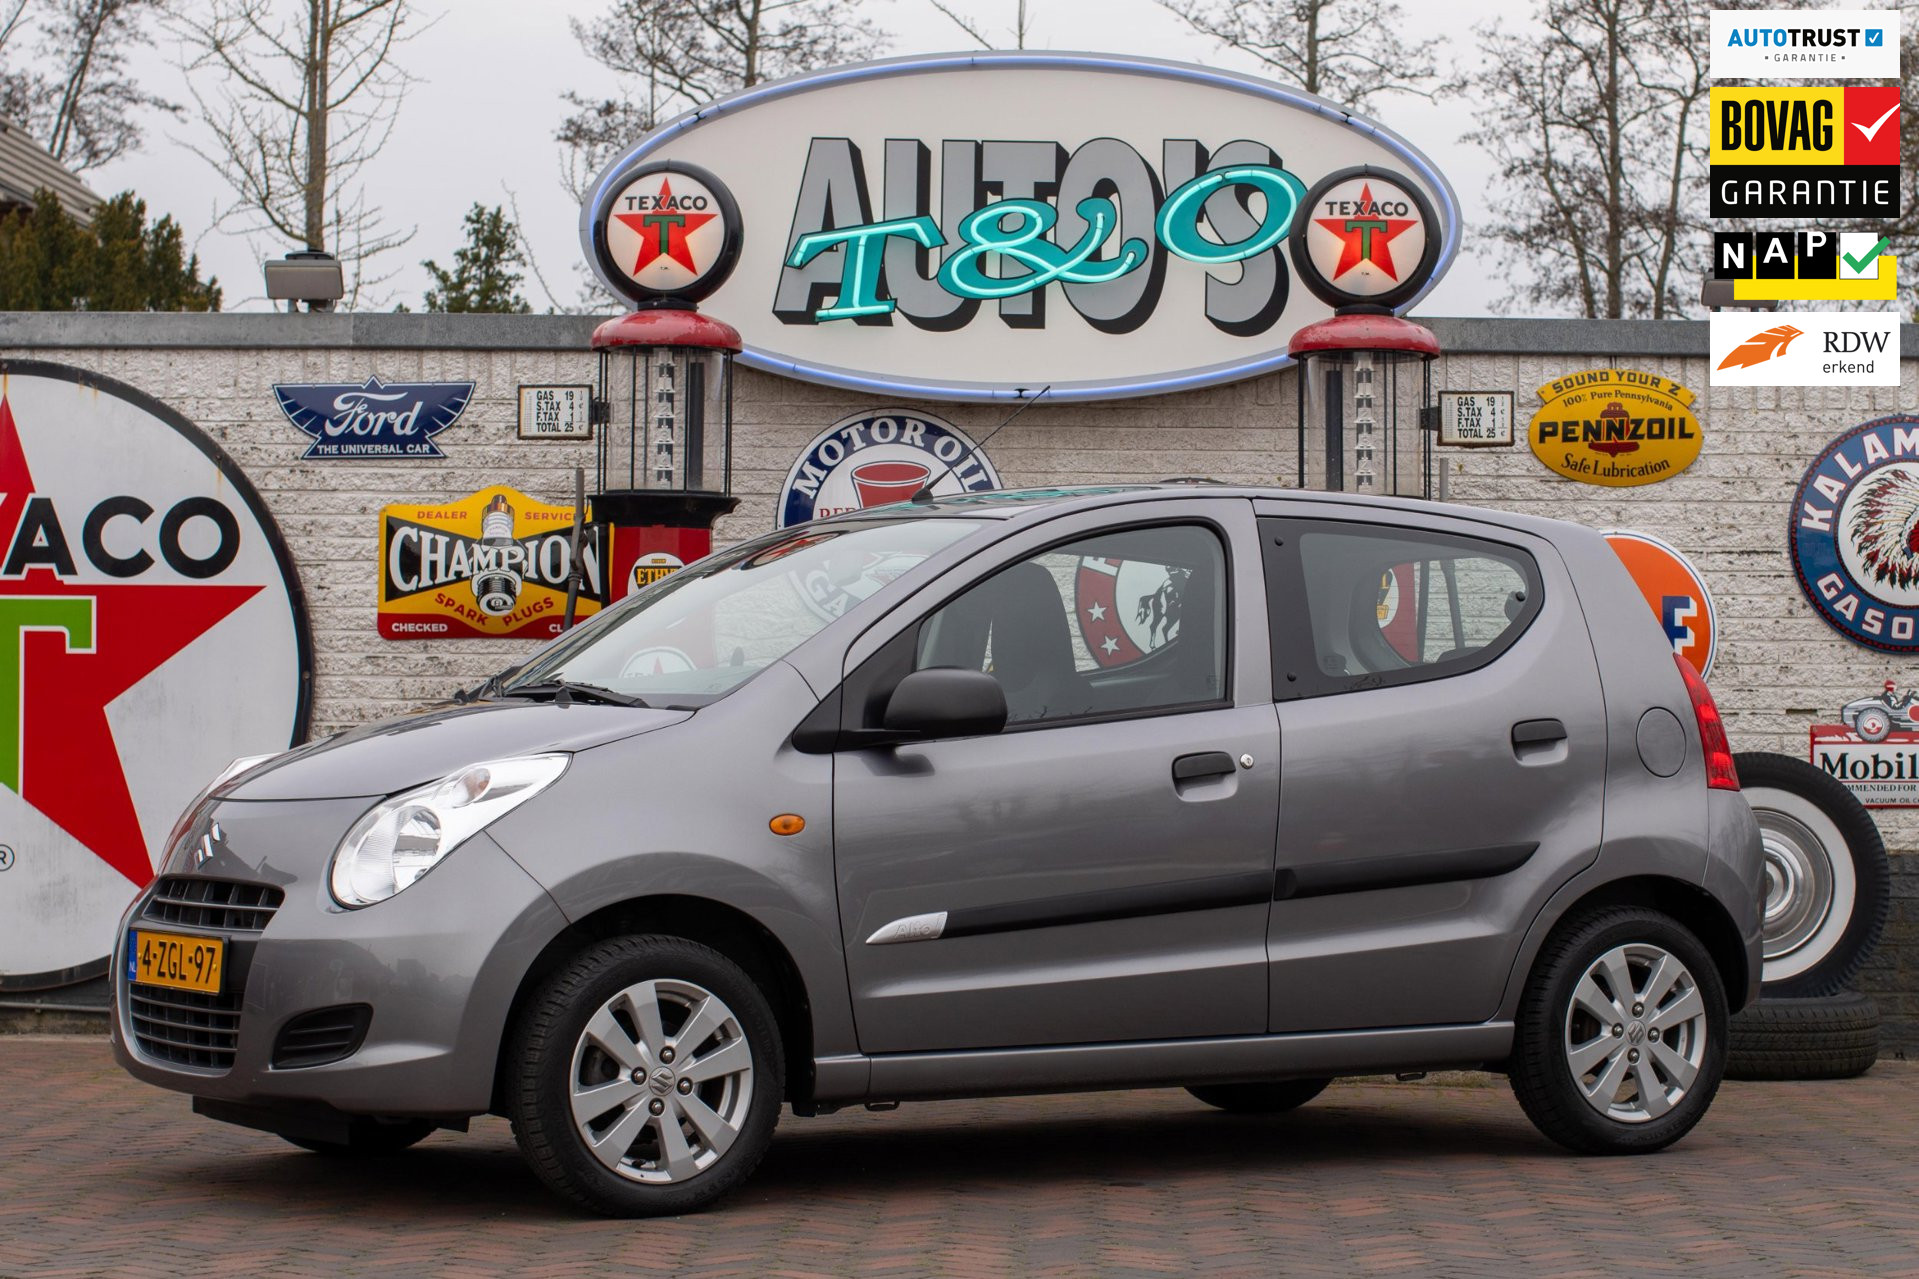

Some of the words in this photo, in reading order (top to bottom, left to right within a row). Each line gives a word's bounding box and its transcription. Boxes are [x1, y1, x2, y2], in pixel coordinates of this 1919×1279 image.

[625, 195, 708, 211] TEXACO
[1325, 201, 1409, 217] TEXACO
[1552, 371, 1610, 394] SOUND
[1615, 371, 1661, 388] YOUR
[536, 390, 554, 401] GAS
[564, 390, 574, 401] 19
[1590, 391, 1613, 401] Pure
[1614, 389, 1674, 412] Pennsylvania
[536, 401, 561, 411] S.TAX
[569, 401, 574, 411] 4
[1457, 396, 1475, 407] GAS
[1486, 396, 1495, 407] 19
[324, 391, 424, 437] Ford
[536, 412, 560, 422] F.TAX
[1457, 407, 1482, 417] S.TAX
[1490, 407, 1496, 417] 4
[536, 422, 561, 432] TOTAL
[564, 422, 574, 432] 25
[1457, 418, 1481, 428] F.TAX
[1457, 428, 1483, 438] TOTAL
[1486, 428, 1496, 438] 25
[1538, 417, 1695, 444] PENNZOIL
[317, 444, 339, 454] THE
[341, 444, 403, 454] UNIVERSAL
[407, 444, 430, 454] CAR
[792, 417, 928, 500] MOTOR
[933, 435, 988, 492] OIL
[1561, 453, 1591, 474] Safe
[1593, 458, 1670, 478] Lubrication
[417, 511, 468, 520] DEALER
[524, 511, 579, 521] SERVIC
[0, 495, 241, 579] ACO
[435, 592, 487, 626] SPARK
[503, 596, 555, 627] PLUGS
[391, 622, 448, 633] CHECKED
[1845, 784, 1897, 792] MMENDED
[1898, 784, 1916, 792] FOR
[129, 961, 137, 973] NL
[142, 939, 216, 984] 4-ZGL-97
